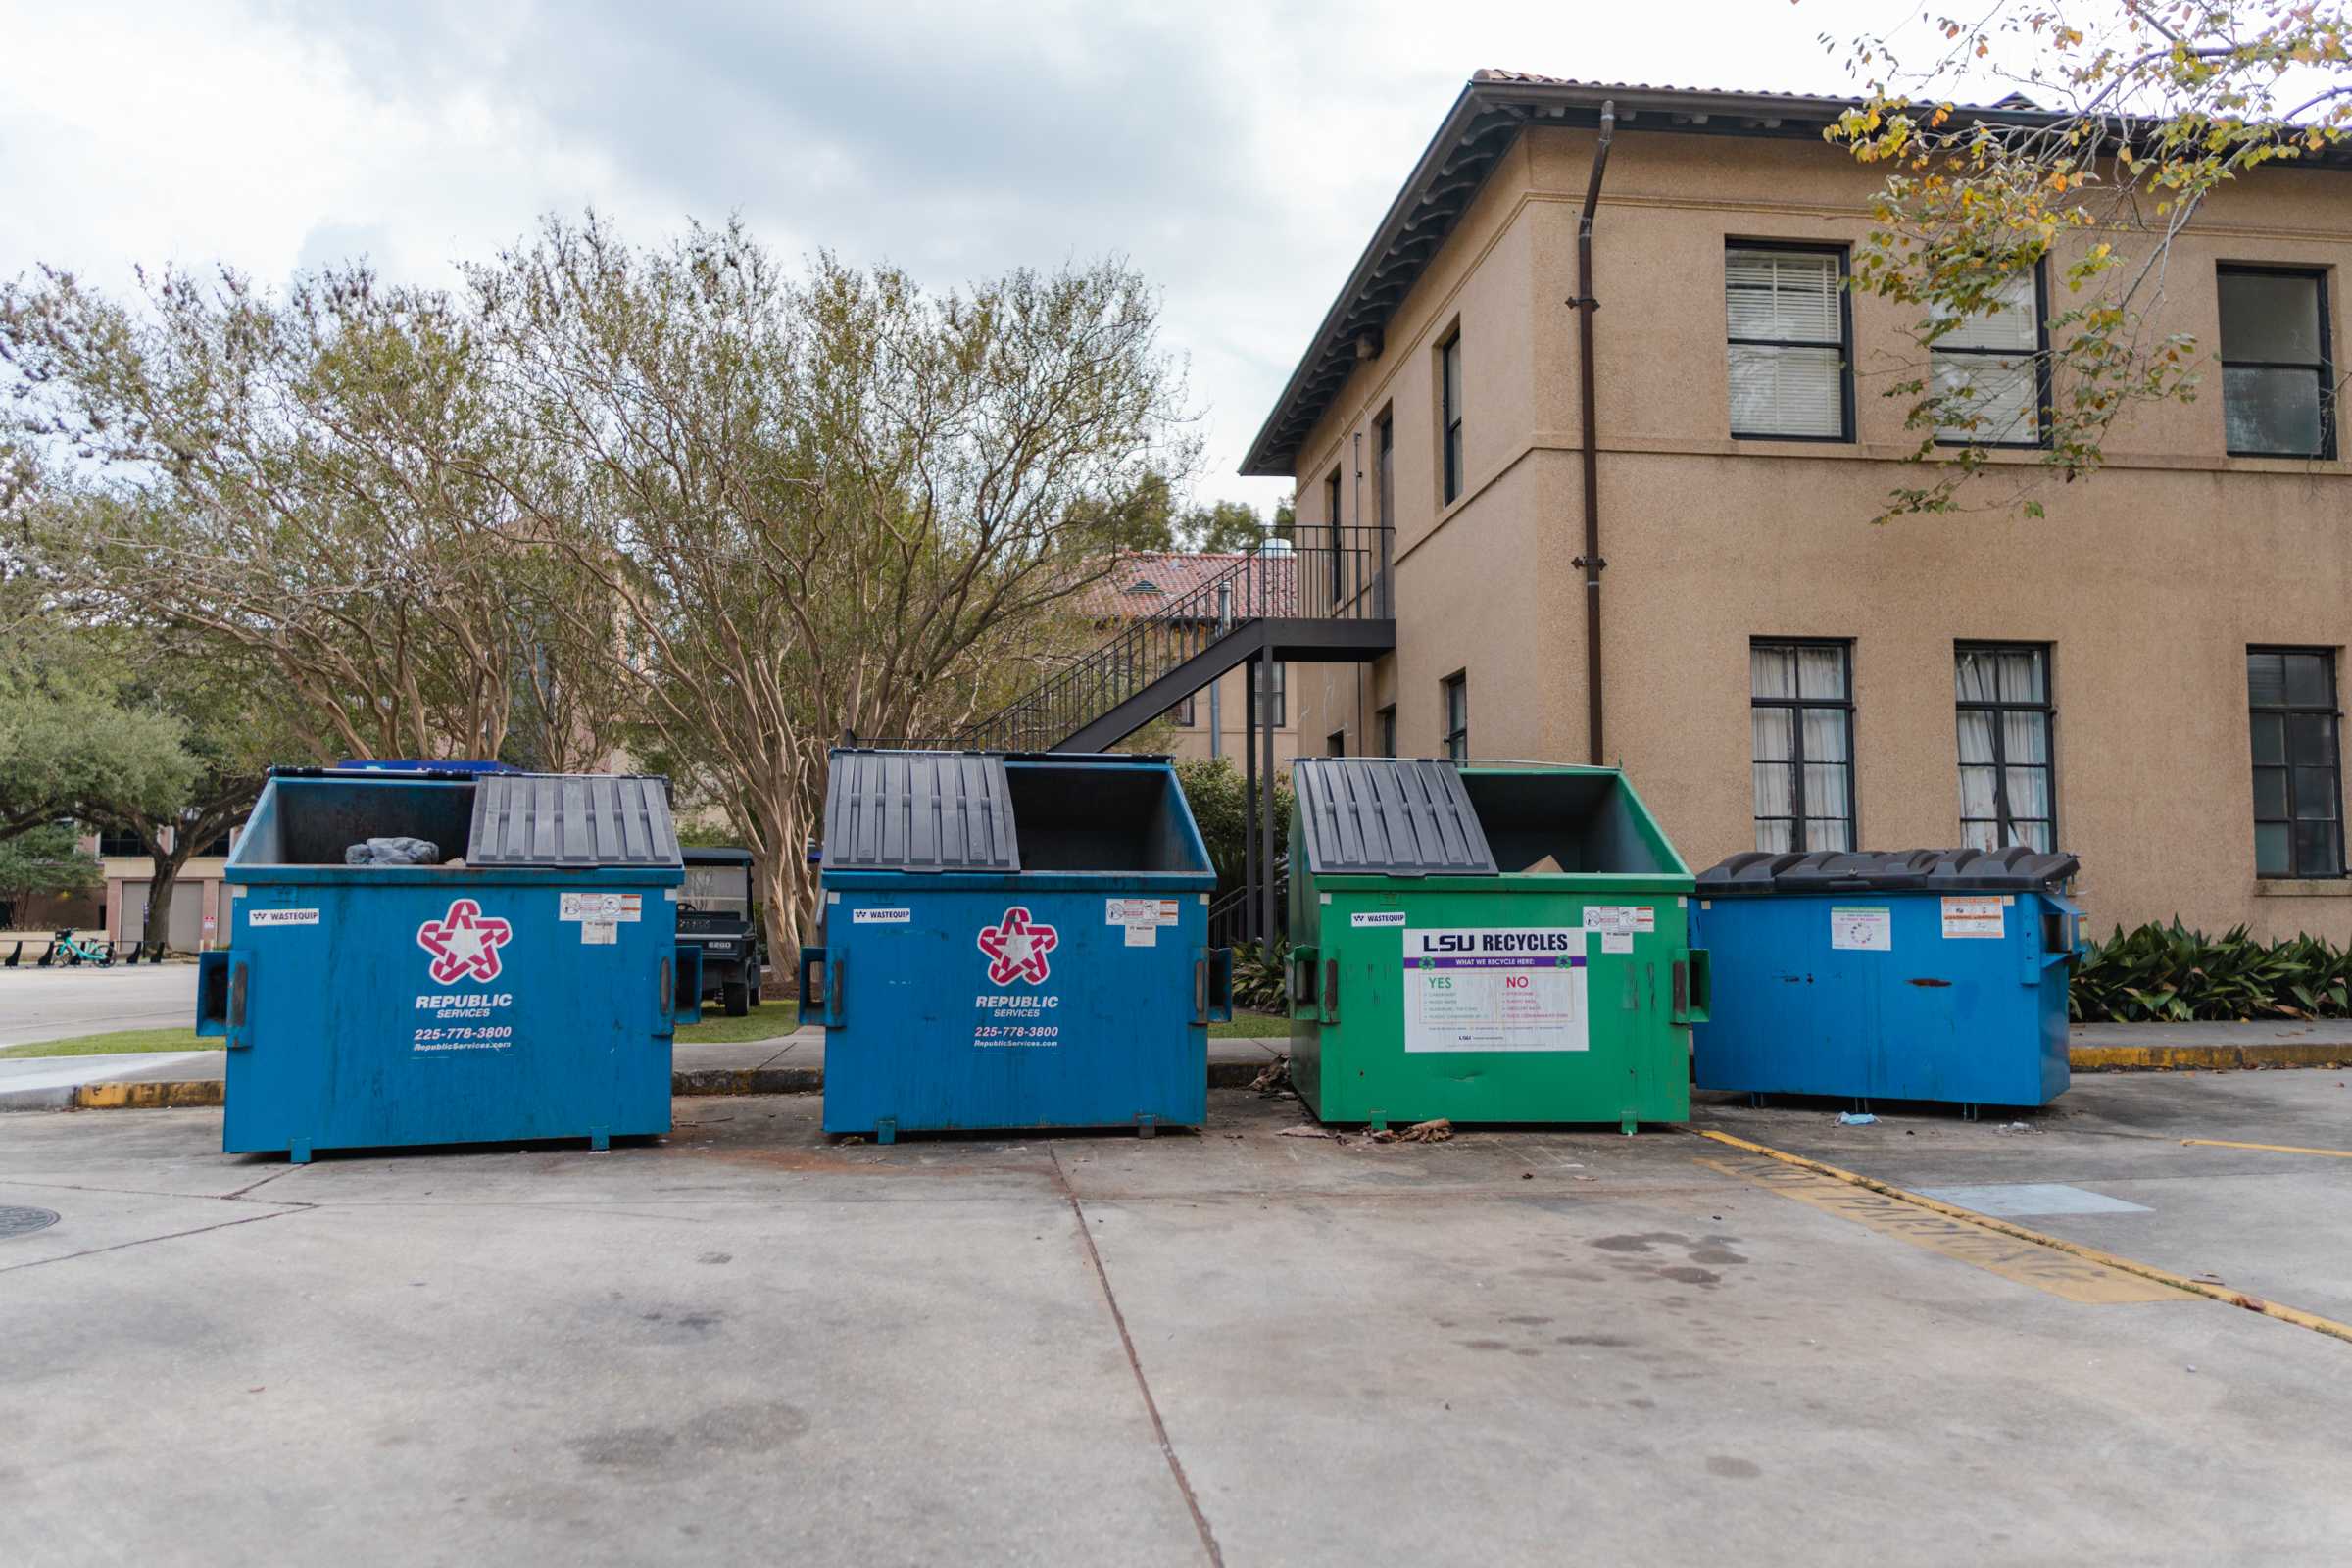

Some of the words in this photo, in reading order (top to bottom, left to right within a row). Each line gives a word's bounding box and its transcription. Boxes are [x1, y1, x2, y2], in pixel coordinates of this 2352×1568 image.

[1423, 934, 1475, 952] LSU
[1482, 933, 1568, 951] RECYCLES
[1429, 977, 1452, 989] YES
[1506, 976, 1529, 988] NO
[416, 993, 513, 1009] REPUBLIC
[975, 995, 1059, 1008] REPUBLIC
[436, 1007, 491, 1019] SERVICES
[993, 1008, 1040, 1018] SERVICES
[414, 1026, 513, 1041] 225-778-3800
[974, 1026, 1058, 1037] 225-778-3800
[413, 1041, 512, 1052] RepublicServices.com
[973, 1039, 1058, 1049] RepublicServices.com
